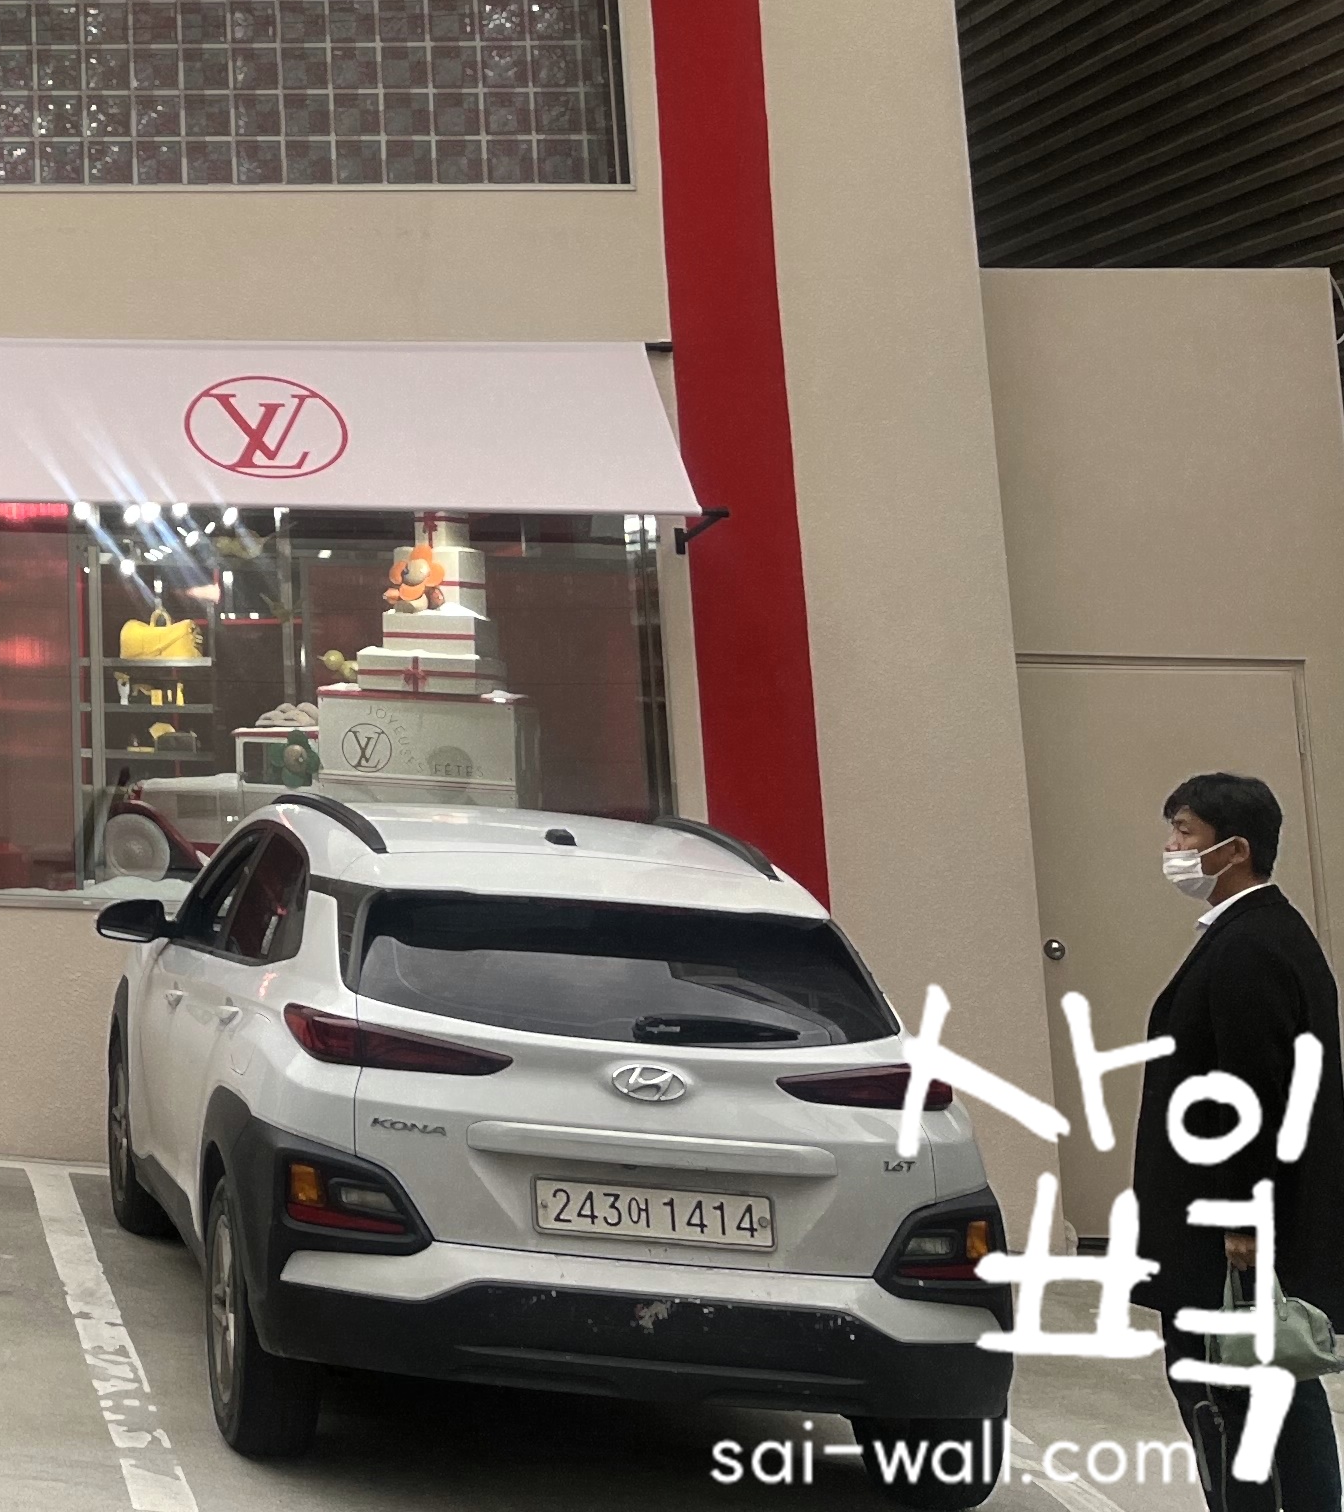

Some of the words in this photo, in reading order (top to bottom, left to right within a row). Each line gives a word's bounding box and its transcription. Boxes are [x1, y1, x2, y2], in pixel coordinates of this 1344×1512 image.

[370, 1117, 447, 1137] KONA
[551, 1187, 651, 1229] 243어
[661, 1196, 759, 1239] 1414
